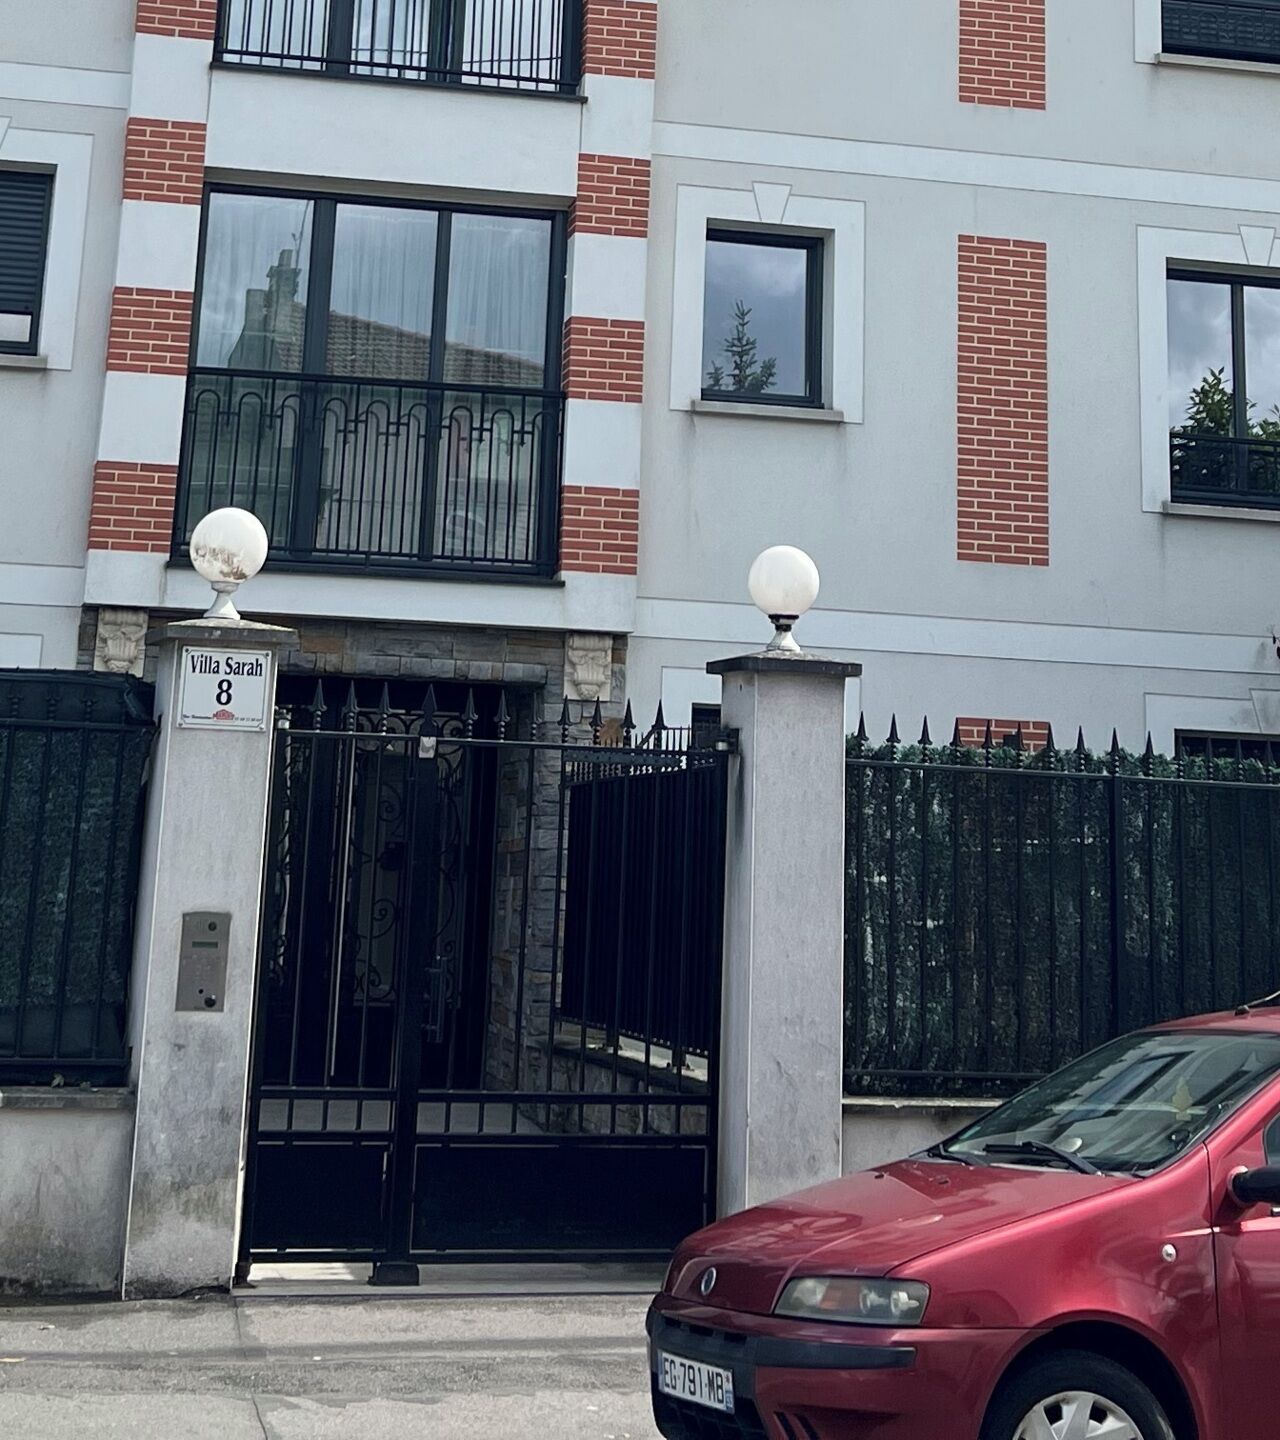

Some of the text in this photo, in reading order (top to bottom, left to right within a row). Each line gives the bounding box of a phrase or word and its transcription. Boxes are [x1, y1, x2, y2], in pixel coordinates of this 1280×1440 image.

[190, 653, 263, 677] Villa Sarah
[215, 678, 233, 706] 8
